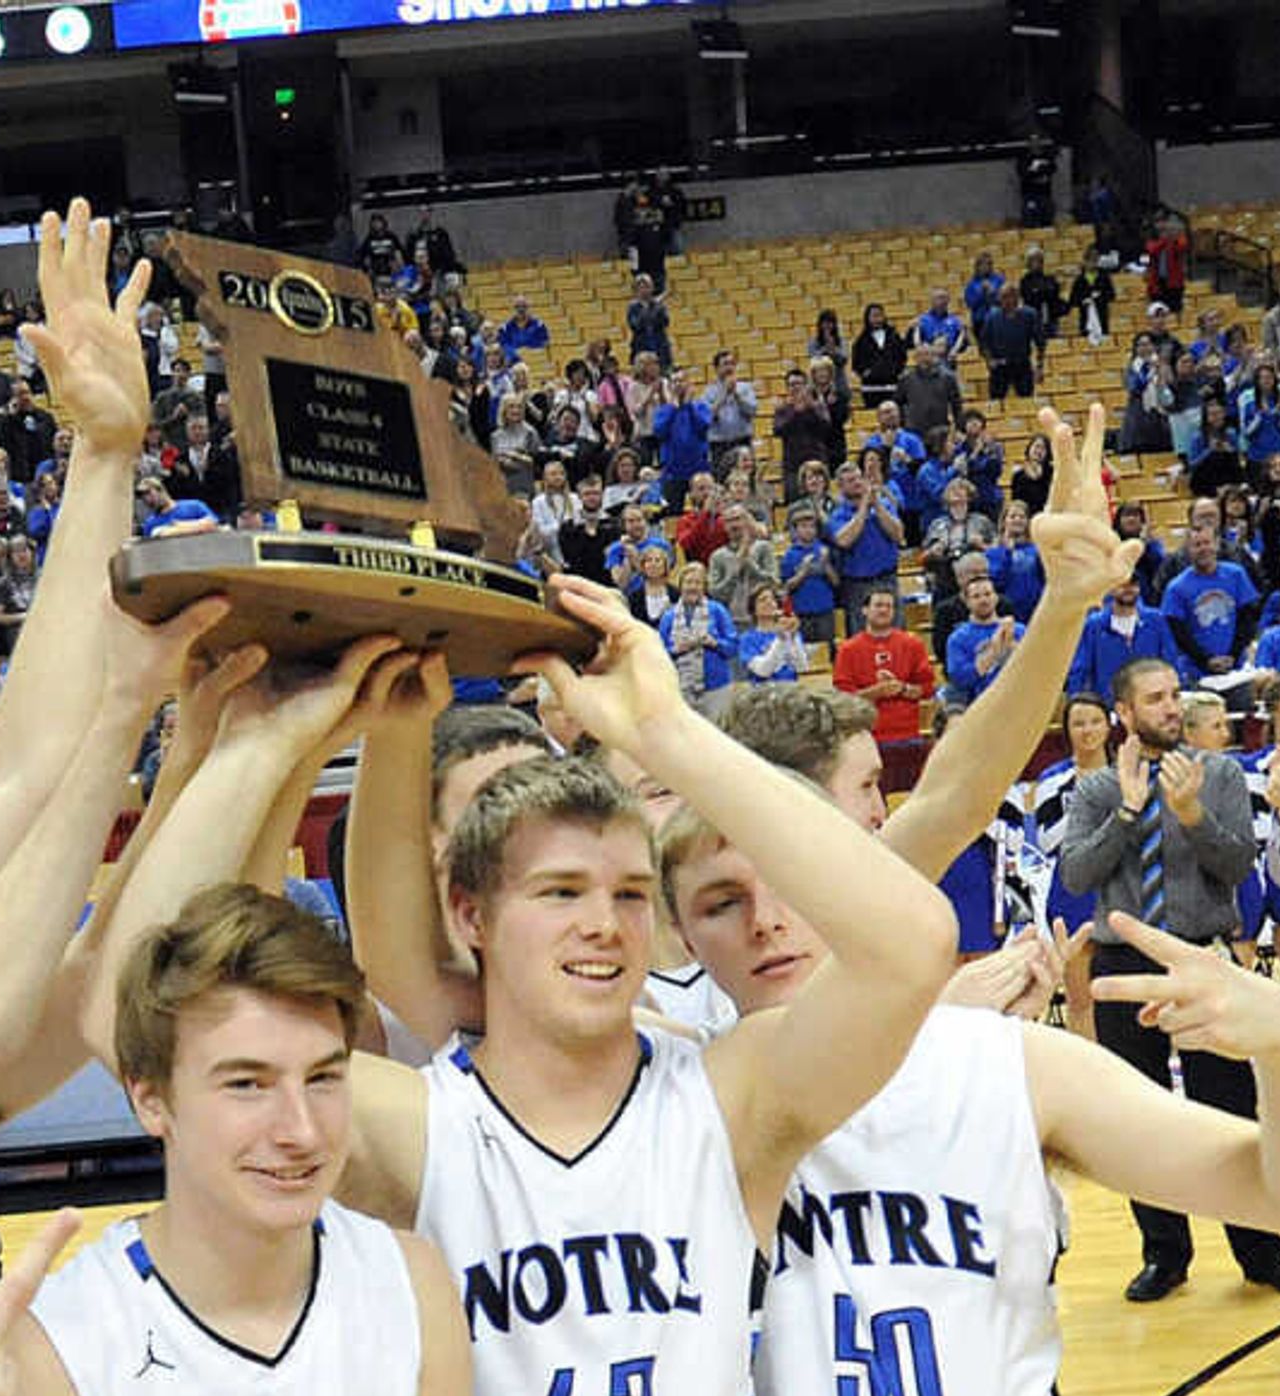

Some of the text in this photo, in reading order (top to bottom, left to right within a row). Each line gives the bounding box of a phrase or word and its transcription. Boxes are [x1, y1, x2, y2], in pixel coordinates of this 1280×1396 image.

[223, 273, 268, 309] 20
[334, 296, 368, 329] 15
[318, 432, 382, 458] STATE
[289, 455, 422, 492] BASKETBALL
[332, 546, 488, 590] THIRD PLACE
